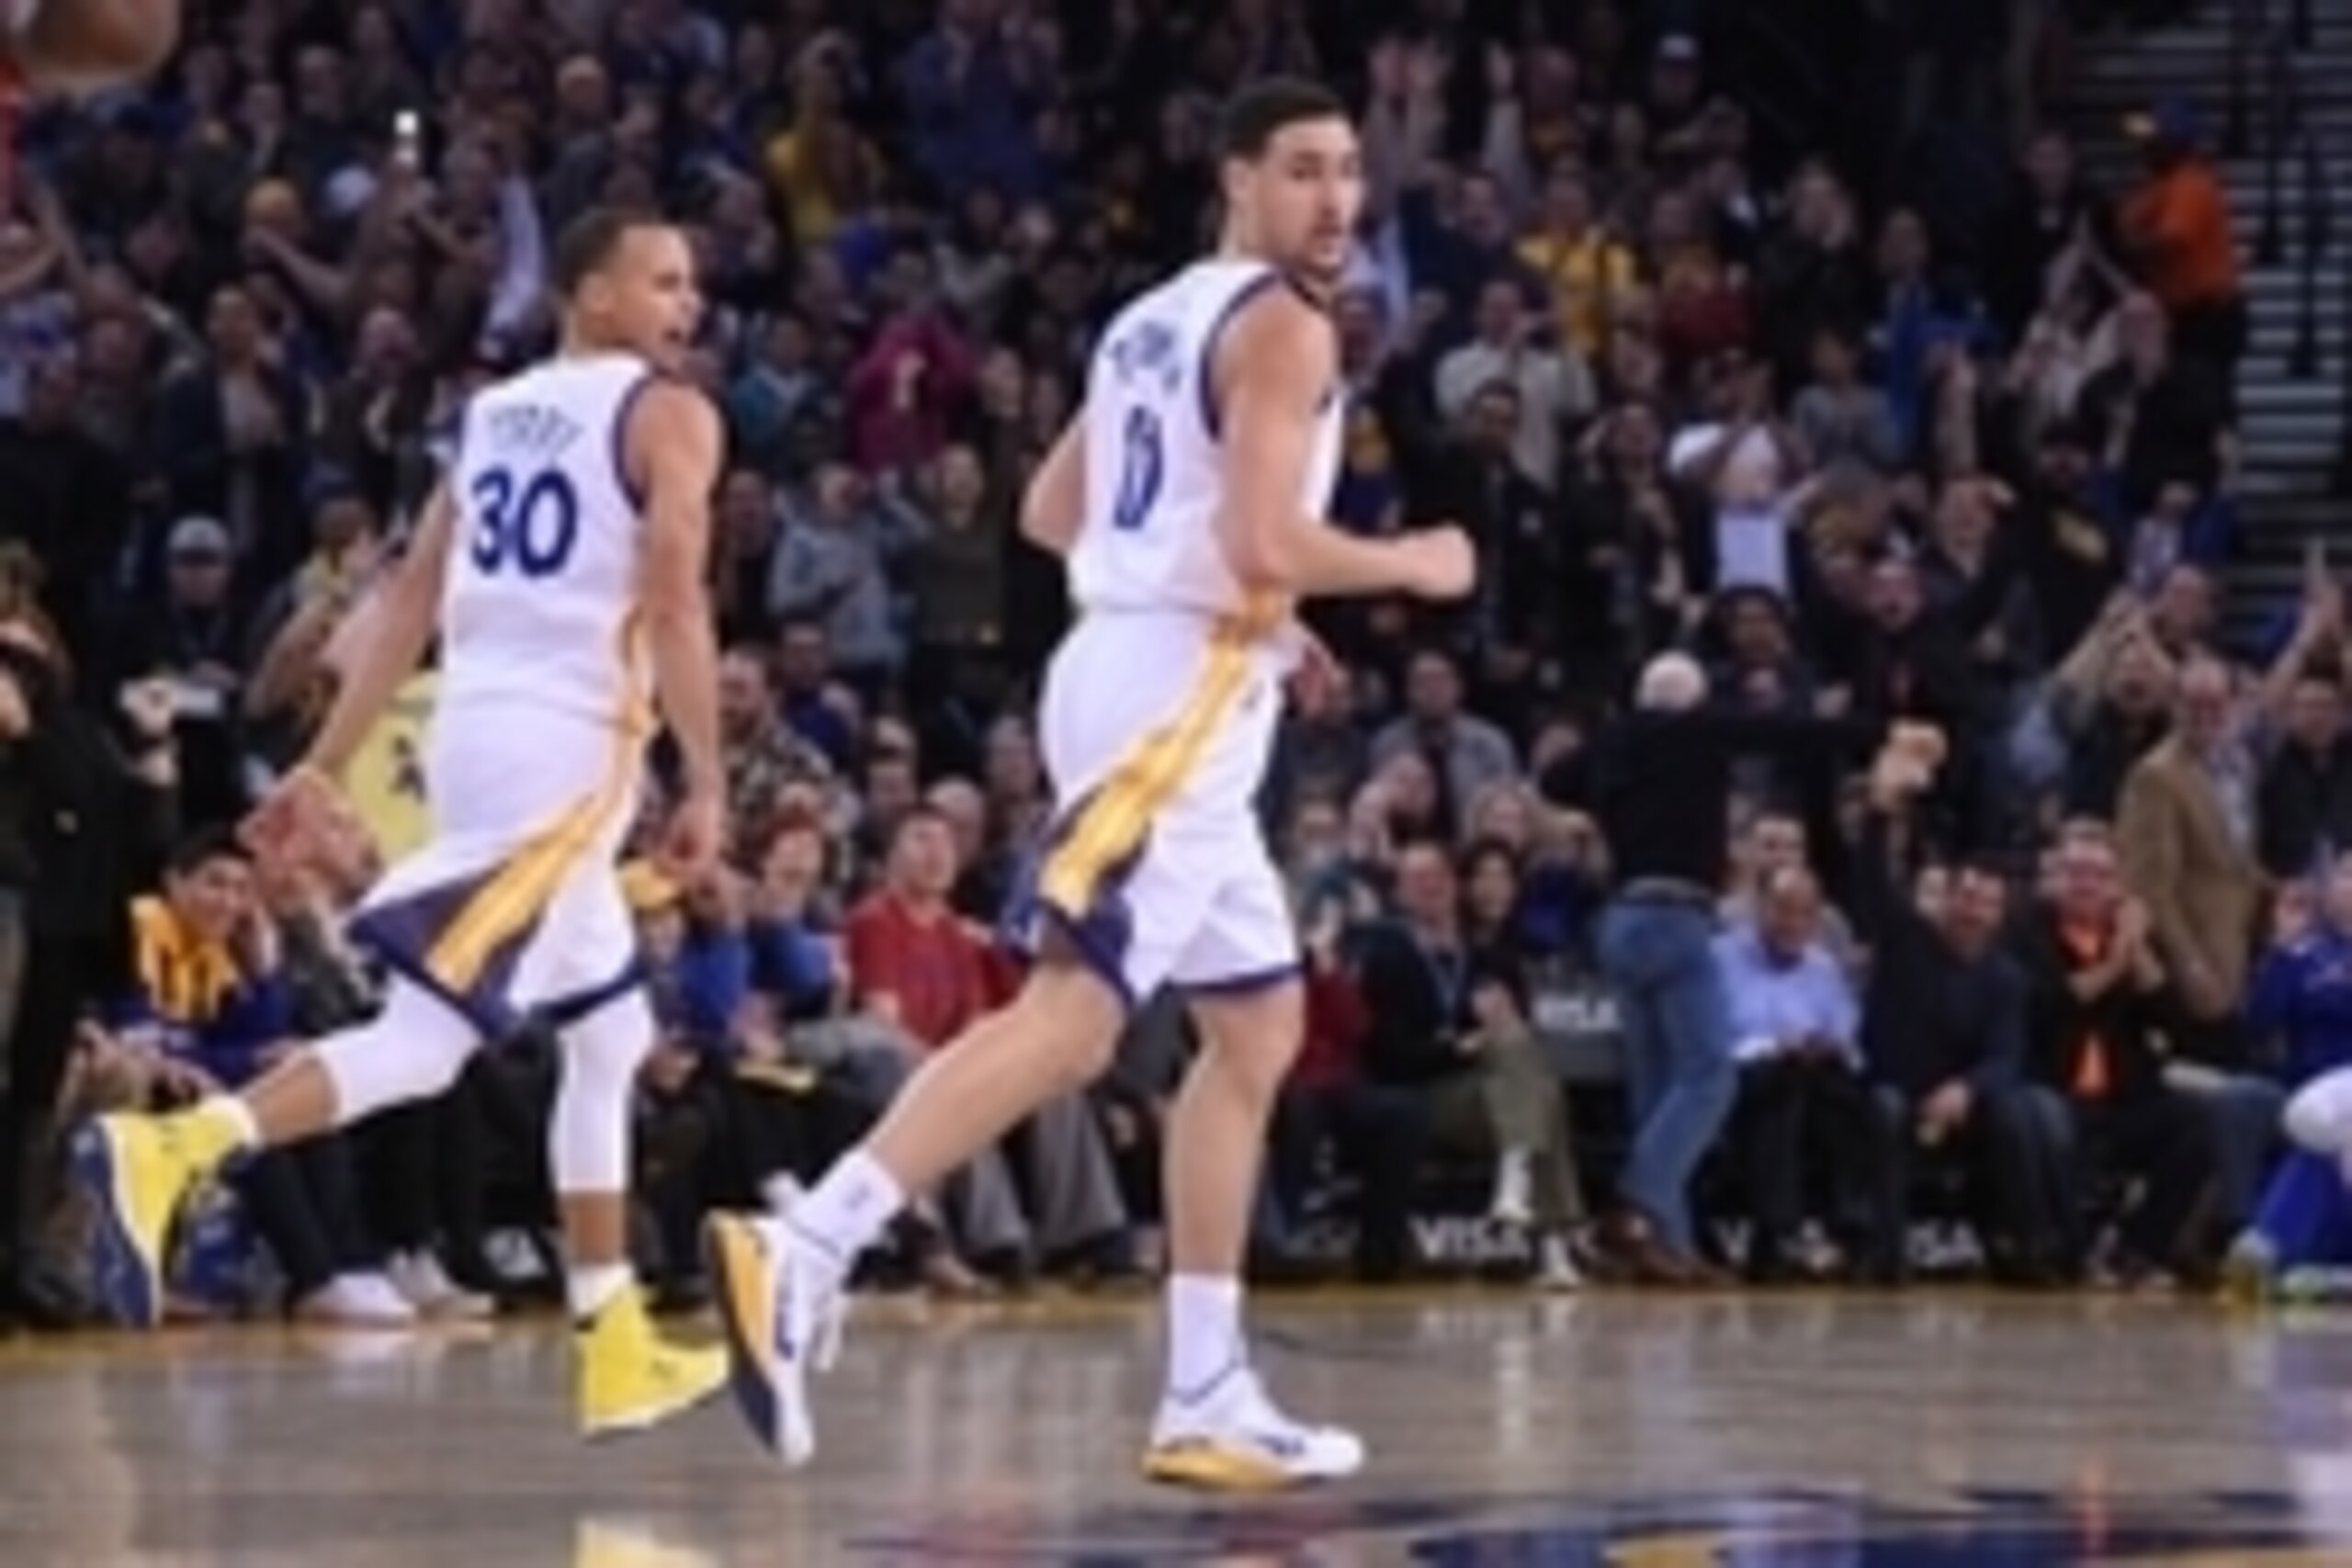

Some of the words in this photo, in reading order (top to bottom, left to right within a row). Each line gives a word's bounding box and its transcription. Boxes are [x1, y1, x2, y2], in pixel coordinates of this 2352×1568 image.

[471, 464, 577, 579] 30
[1408, 1215, 1531, 1259] VISA
[1905, 1217, 1984, 1267] ISA
